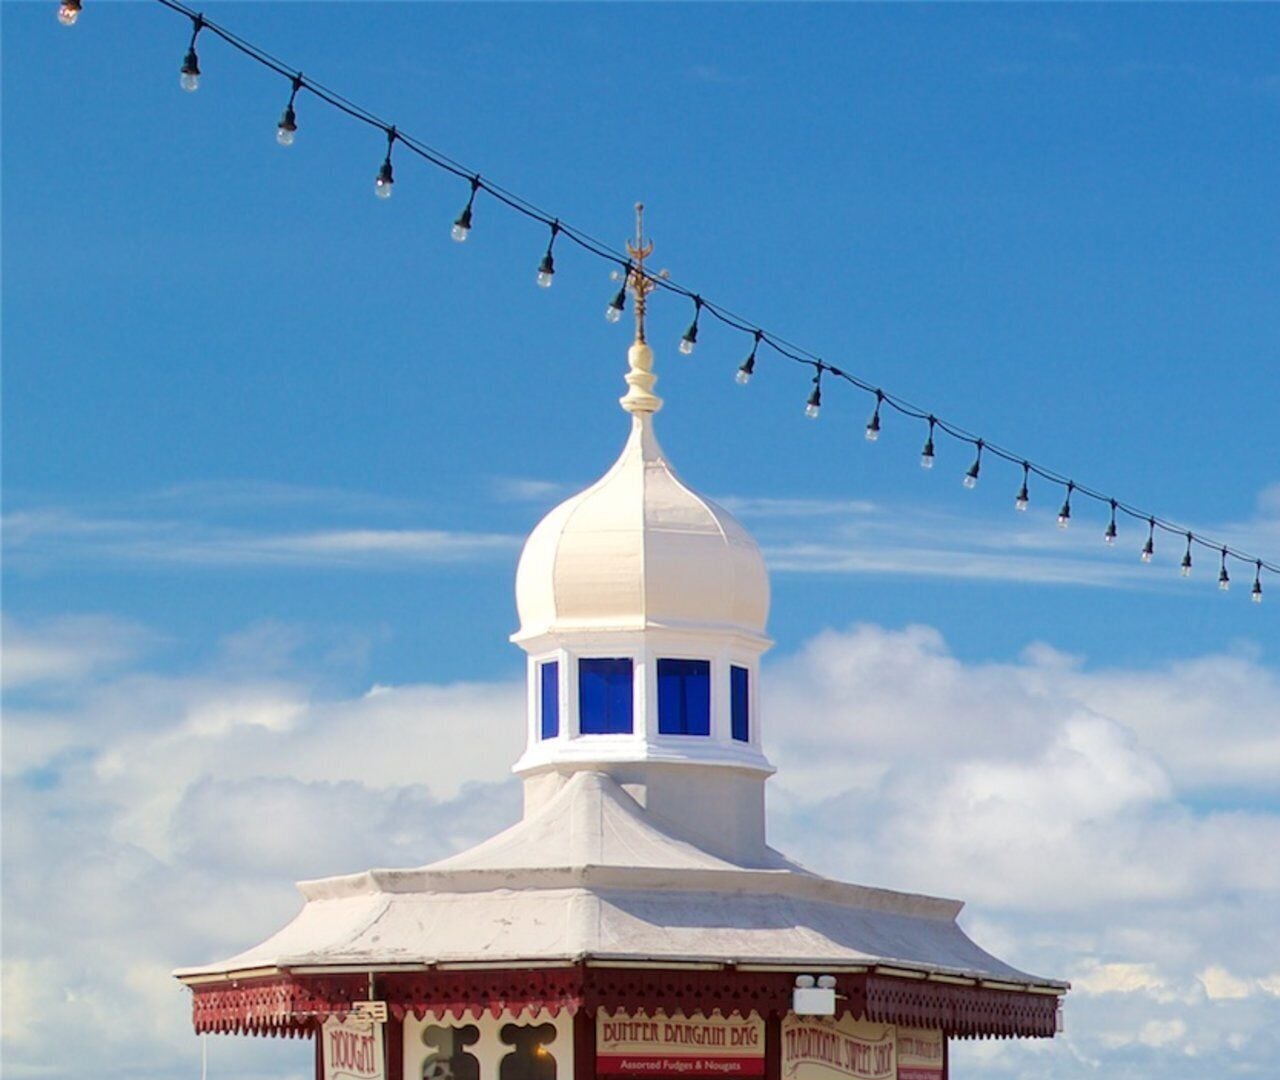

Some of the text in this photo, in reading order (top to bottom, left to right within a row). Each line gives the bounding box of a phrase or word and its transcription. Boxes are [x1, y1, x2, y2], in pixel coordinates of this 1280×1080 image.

[603, 1022, 758, 1046] BUMPER BARGAIN BAG
[329, 1030, 375, 1073] NOUGAT
[620, 1059, 741, 1073] Assorted Fudges & Nougats
[785, 1027, 842, 1067] TRADITIONAL
[844, 1038, 872, 1075] SWEET
[873, 1042, 893, 1075] SHOP
